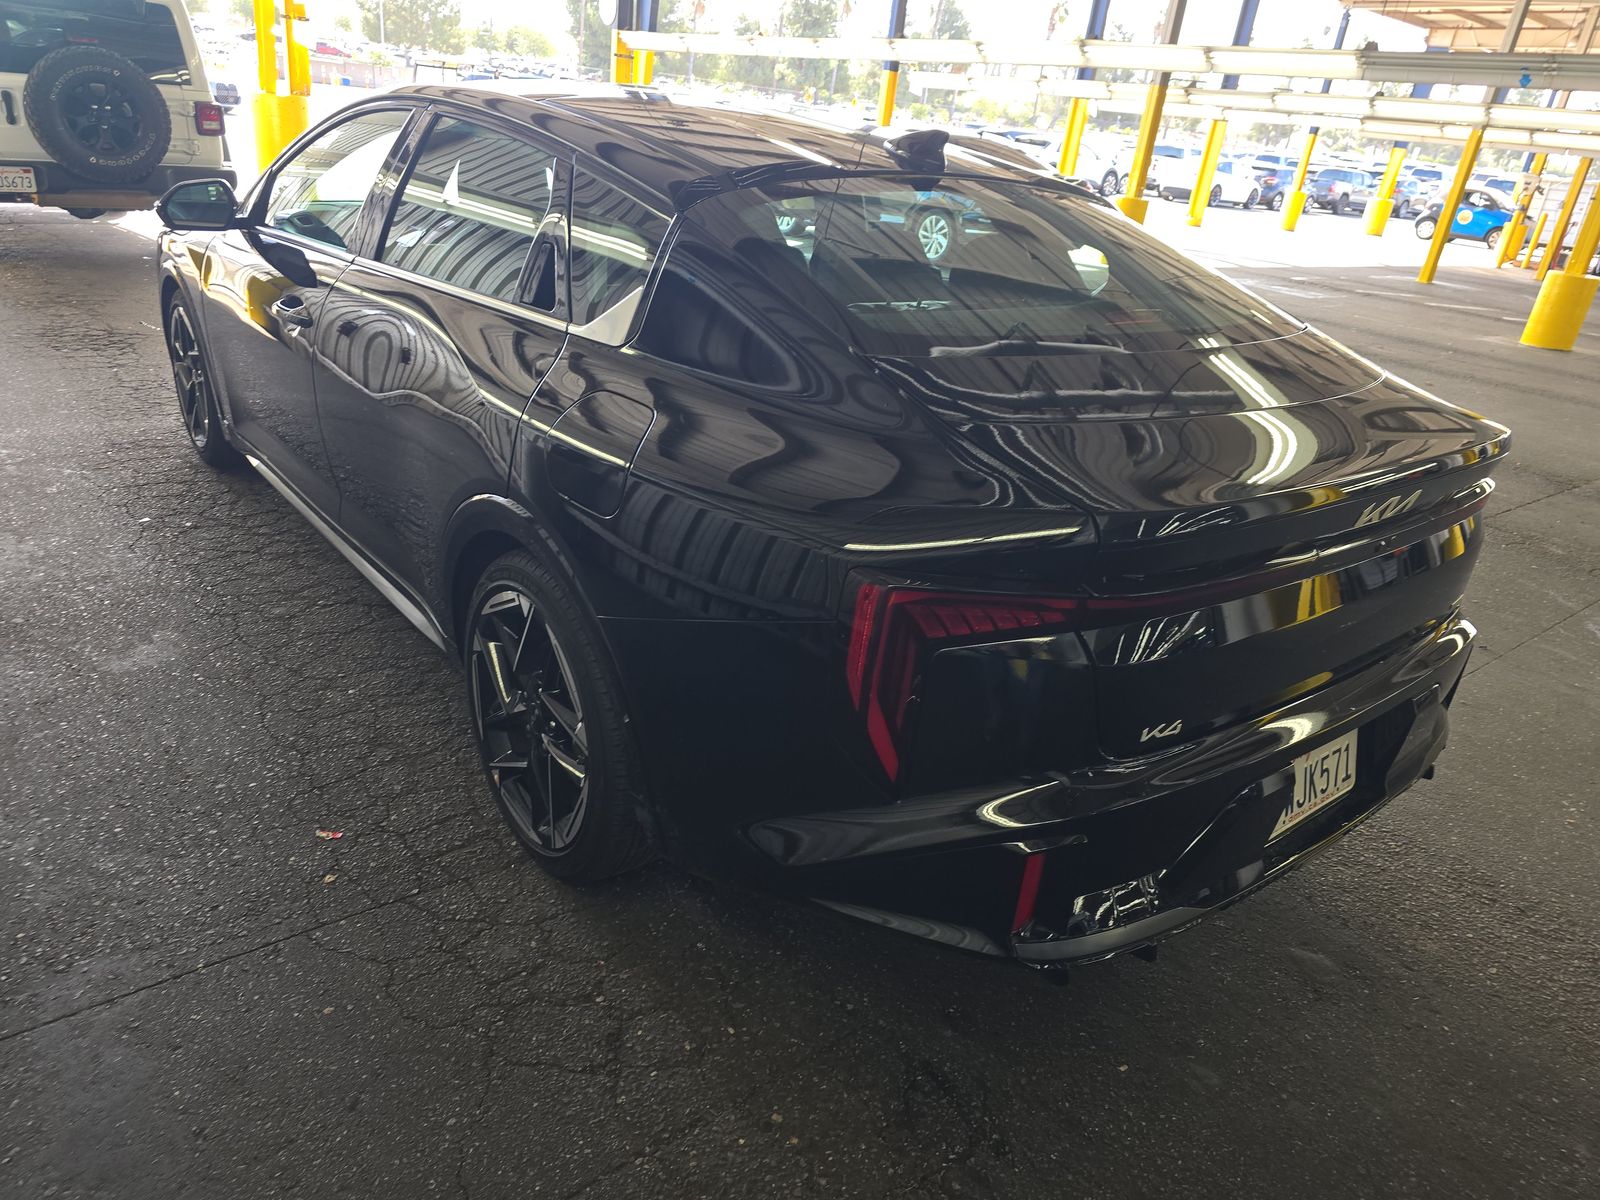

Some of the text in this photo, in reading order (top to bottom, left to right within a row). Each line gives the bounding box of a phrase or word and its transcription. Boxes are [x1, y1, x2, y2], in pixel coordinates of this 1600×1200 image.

[1353, 488, 1423, 528] KIA
[1140, 719, 1183, 743] K4
[1285, 743, 1351, 818] JK571
